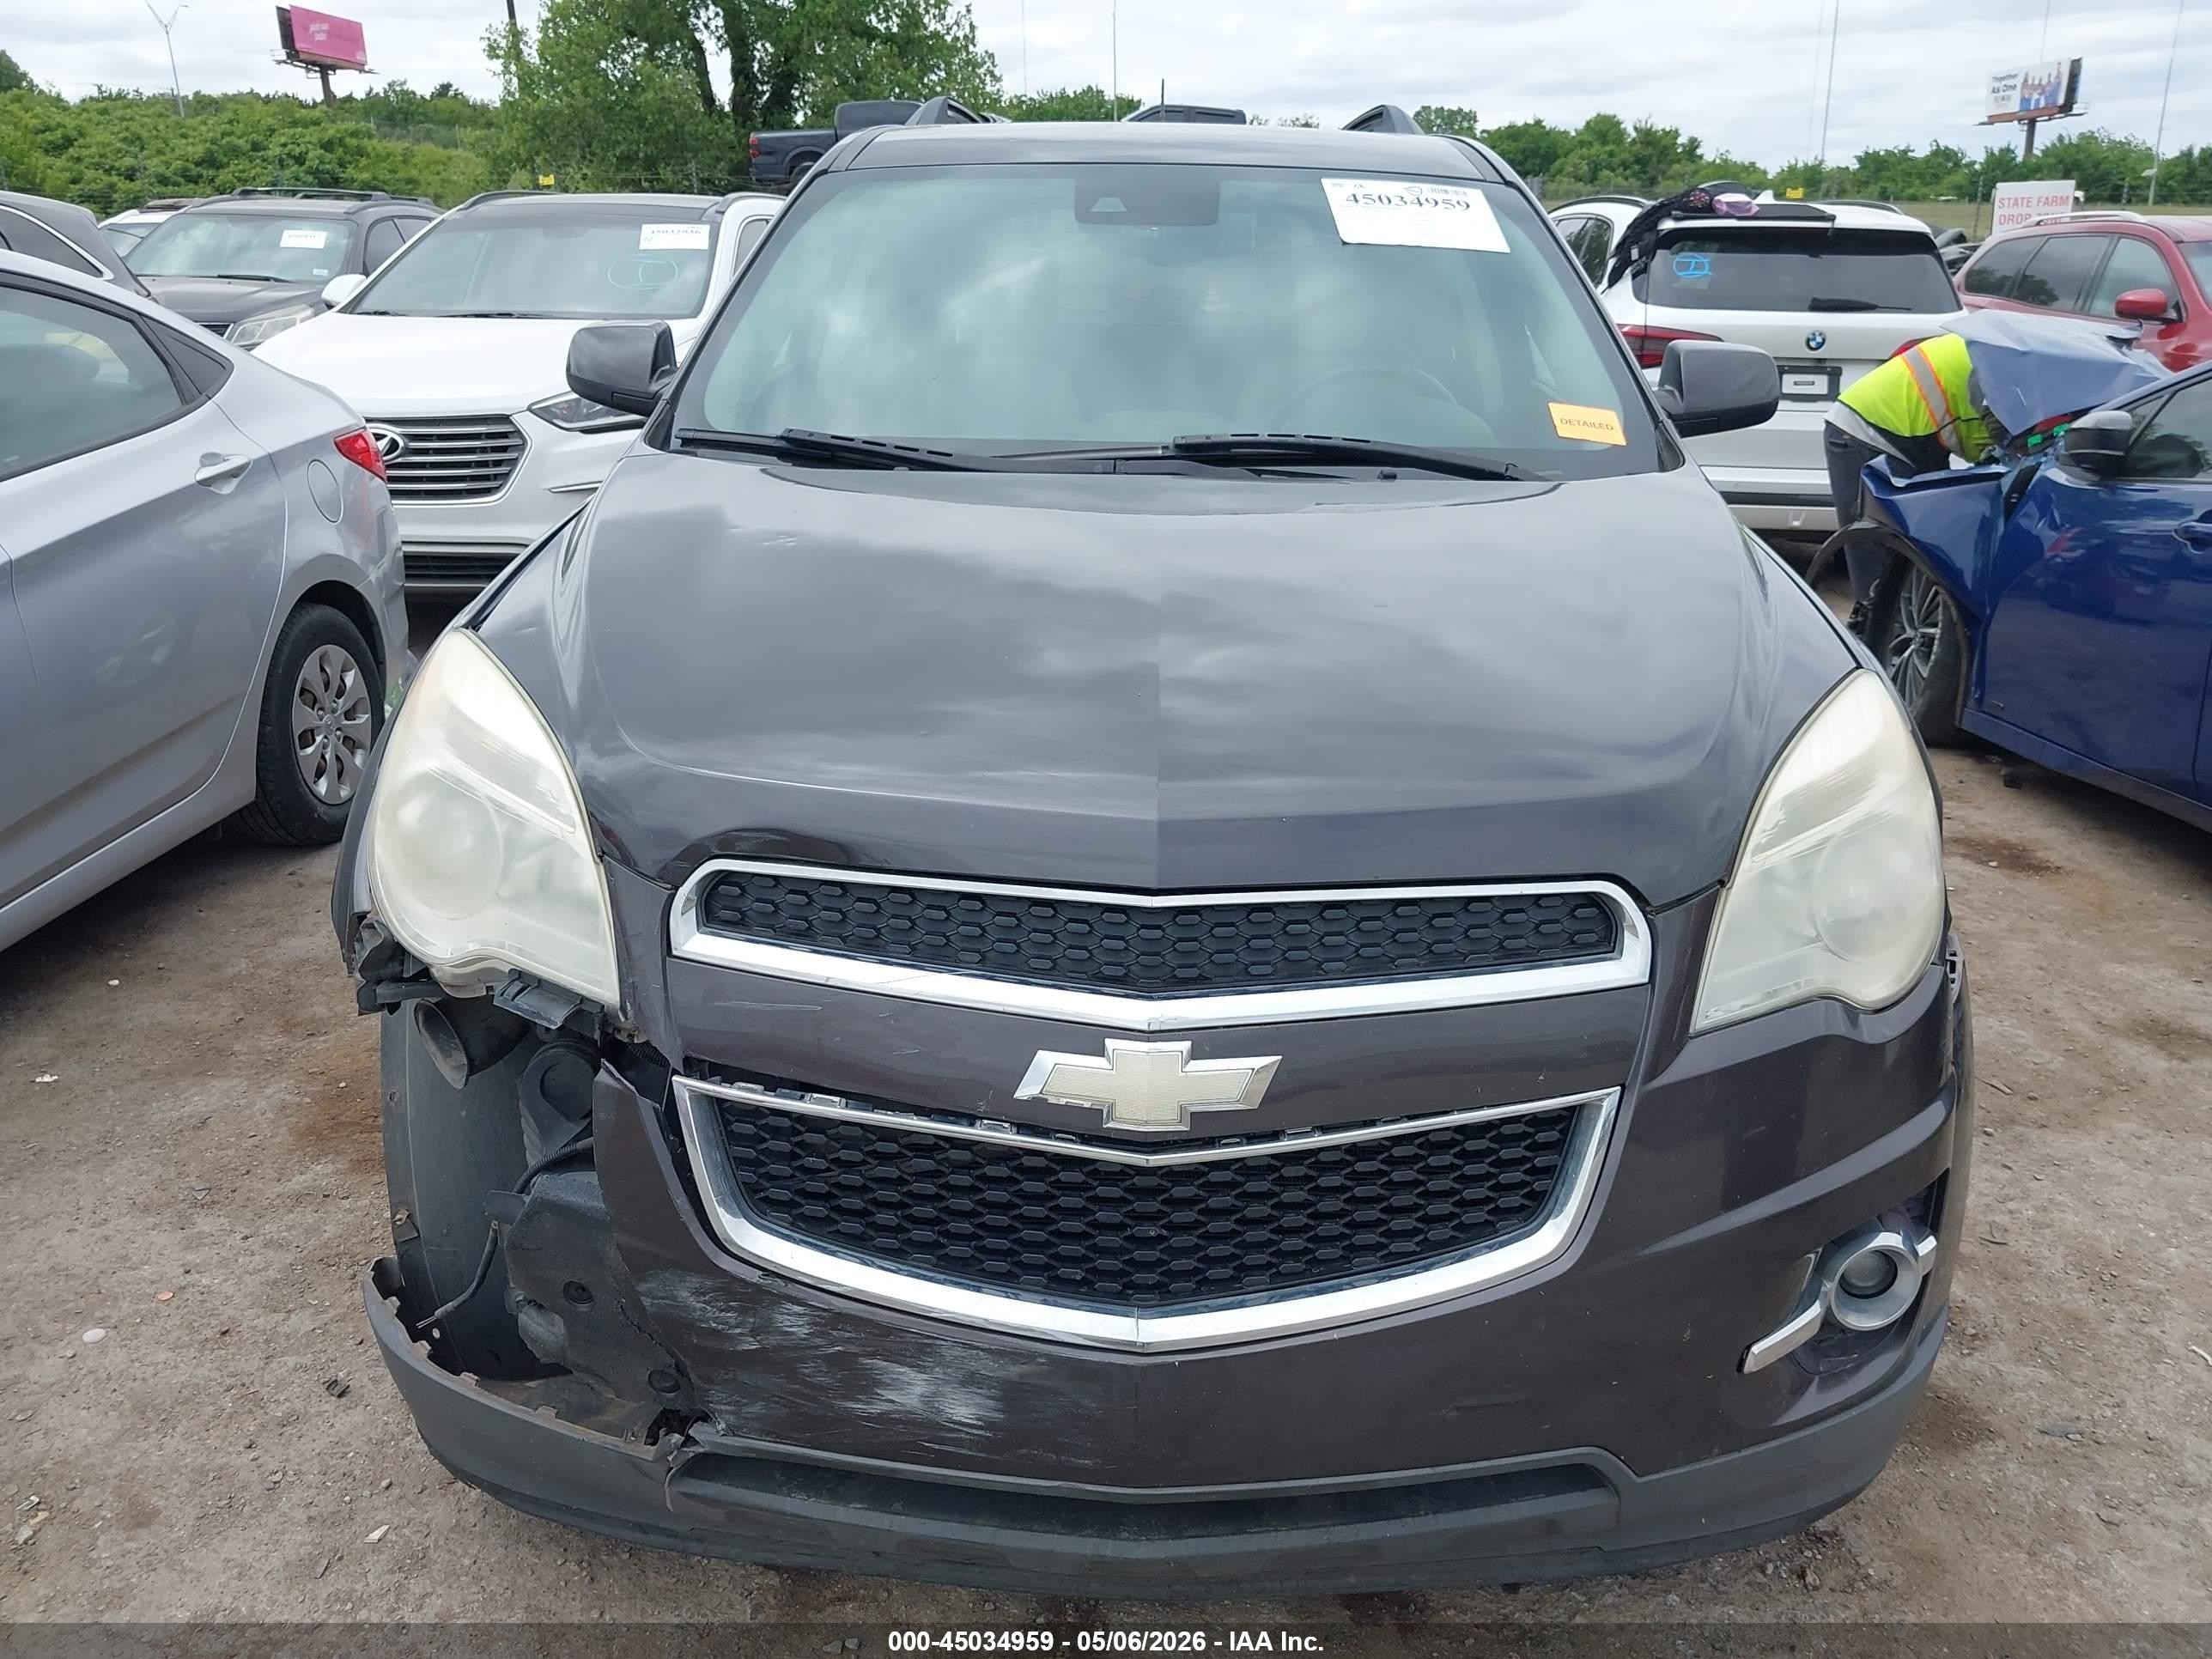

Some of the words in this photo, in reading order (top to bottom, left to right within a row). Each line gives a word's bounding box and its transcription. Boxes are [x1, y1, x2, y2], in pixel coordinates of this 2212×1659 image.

[1346, 192, 1471, 211] 45034959
[1998, 197, 2033, 209] STATE
[2036, 195, 2069, 207] FARM
[1999, 213, 2032, 225] DROP
[1559, 417, 1614, 431] DETAILED
